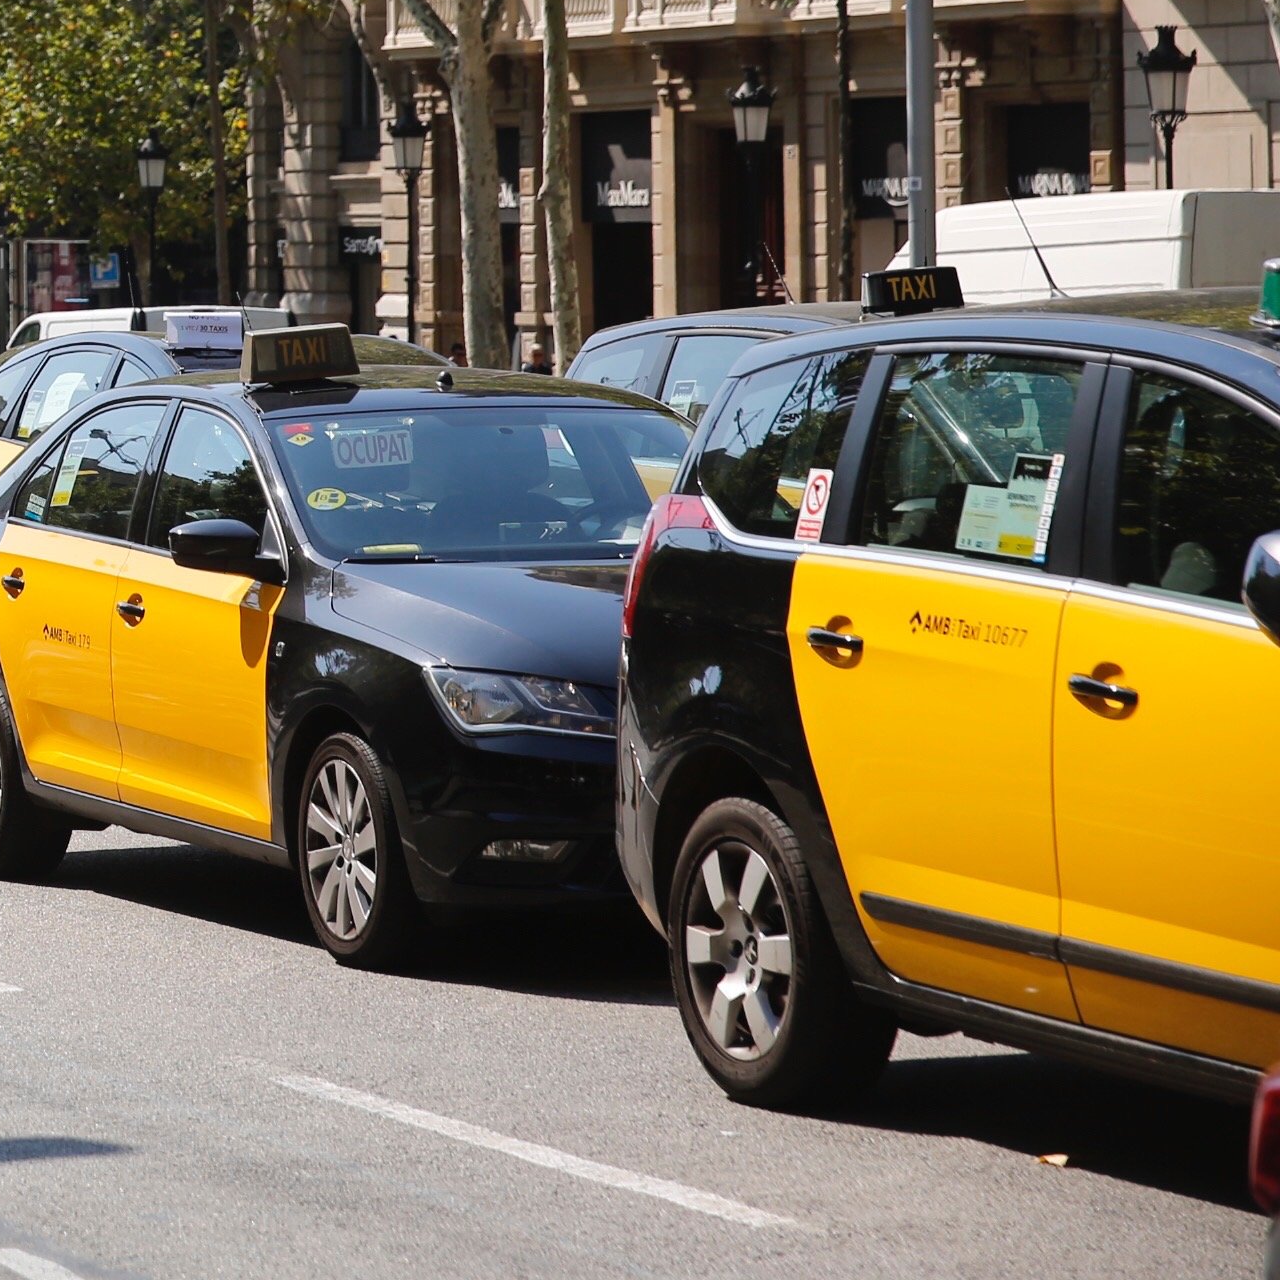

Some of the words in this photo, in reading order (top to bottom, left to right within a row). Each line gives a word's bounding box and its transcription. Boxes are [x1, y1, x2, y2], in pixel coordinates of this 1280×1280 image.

[596, 179, 650, 207] MaxMara
[886, 274, 937, 302] TAXI
[209, 325, 228, 333] TAXIS
[278, 337, 328, 367] TAXI
[337, 432, 409, 466] OCUPAT
[50, 626, 63, 642] AMB
[65, 630, 77, 646] Taxi
[78, 633, 91, 650] 179
[923, 614, 951, 636] AMB
[957, 618, 982, 641] Taxi
[983, 624, 1028, 648] 10677
